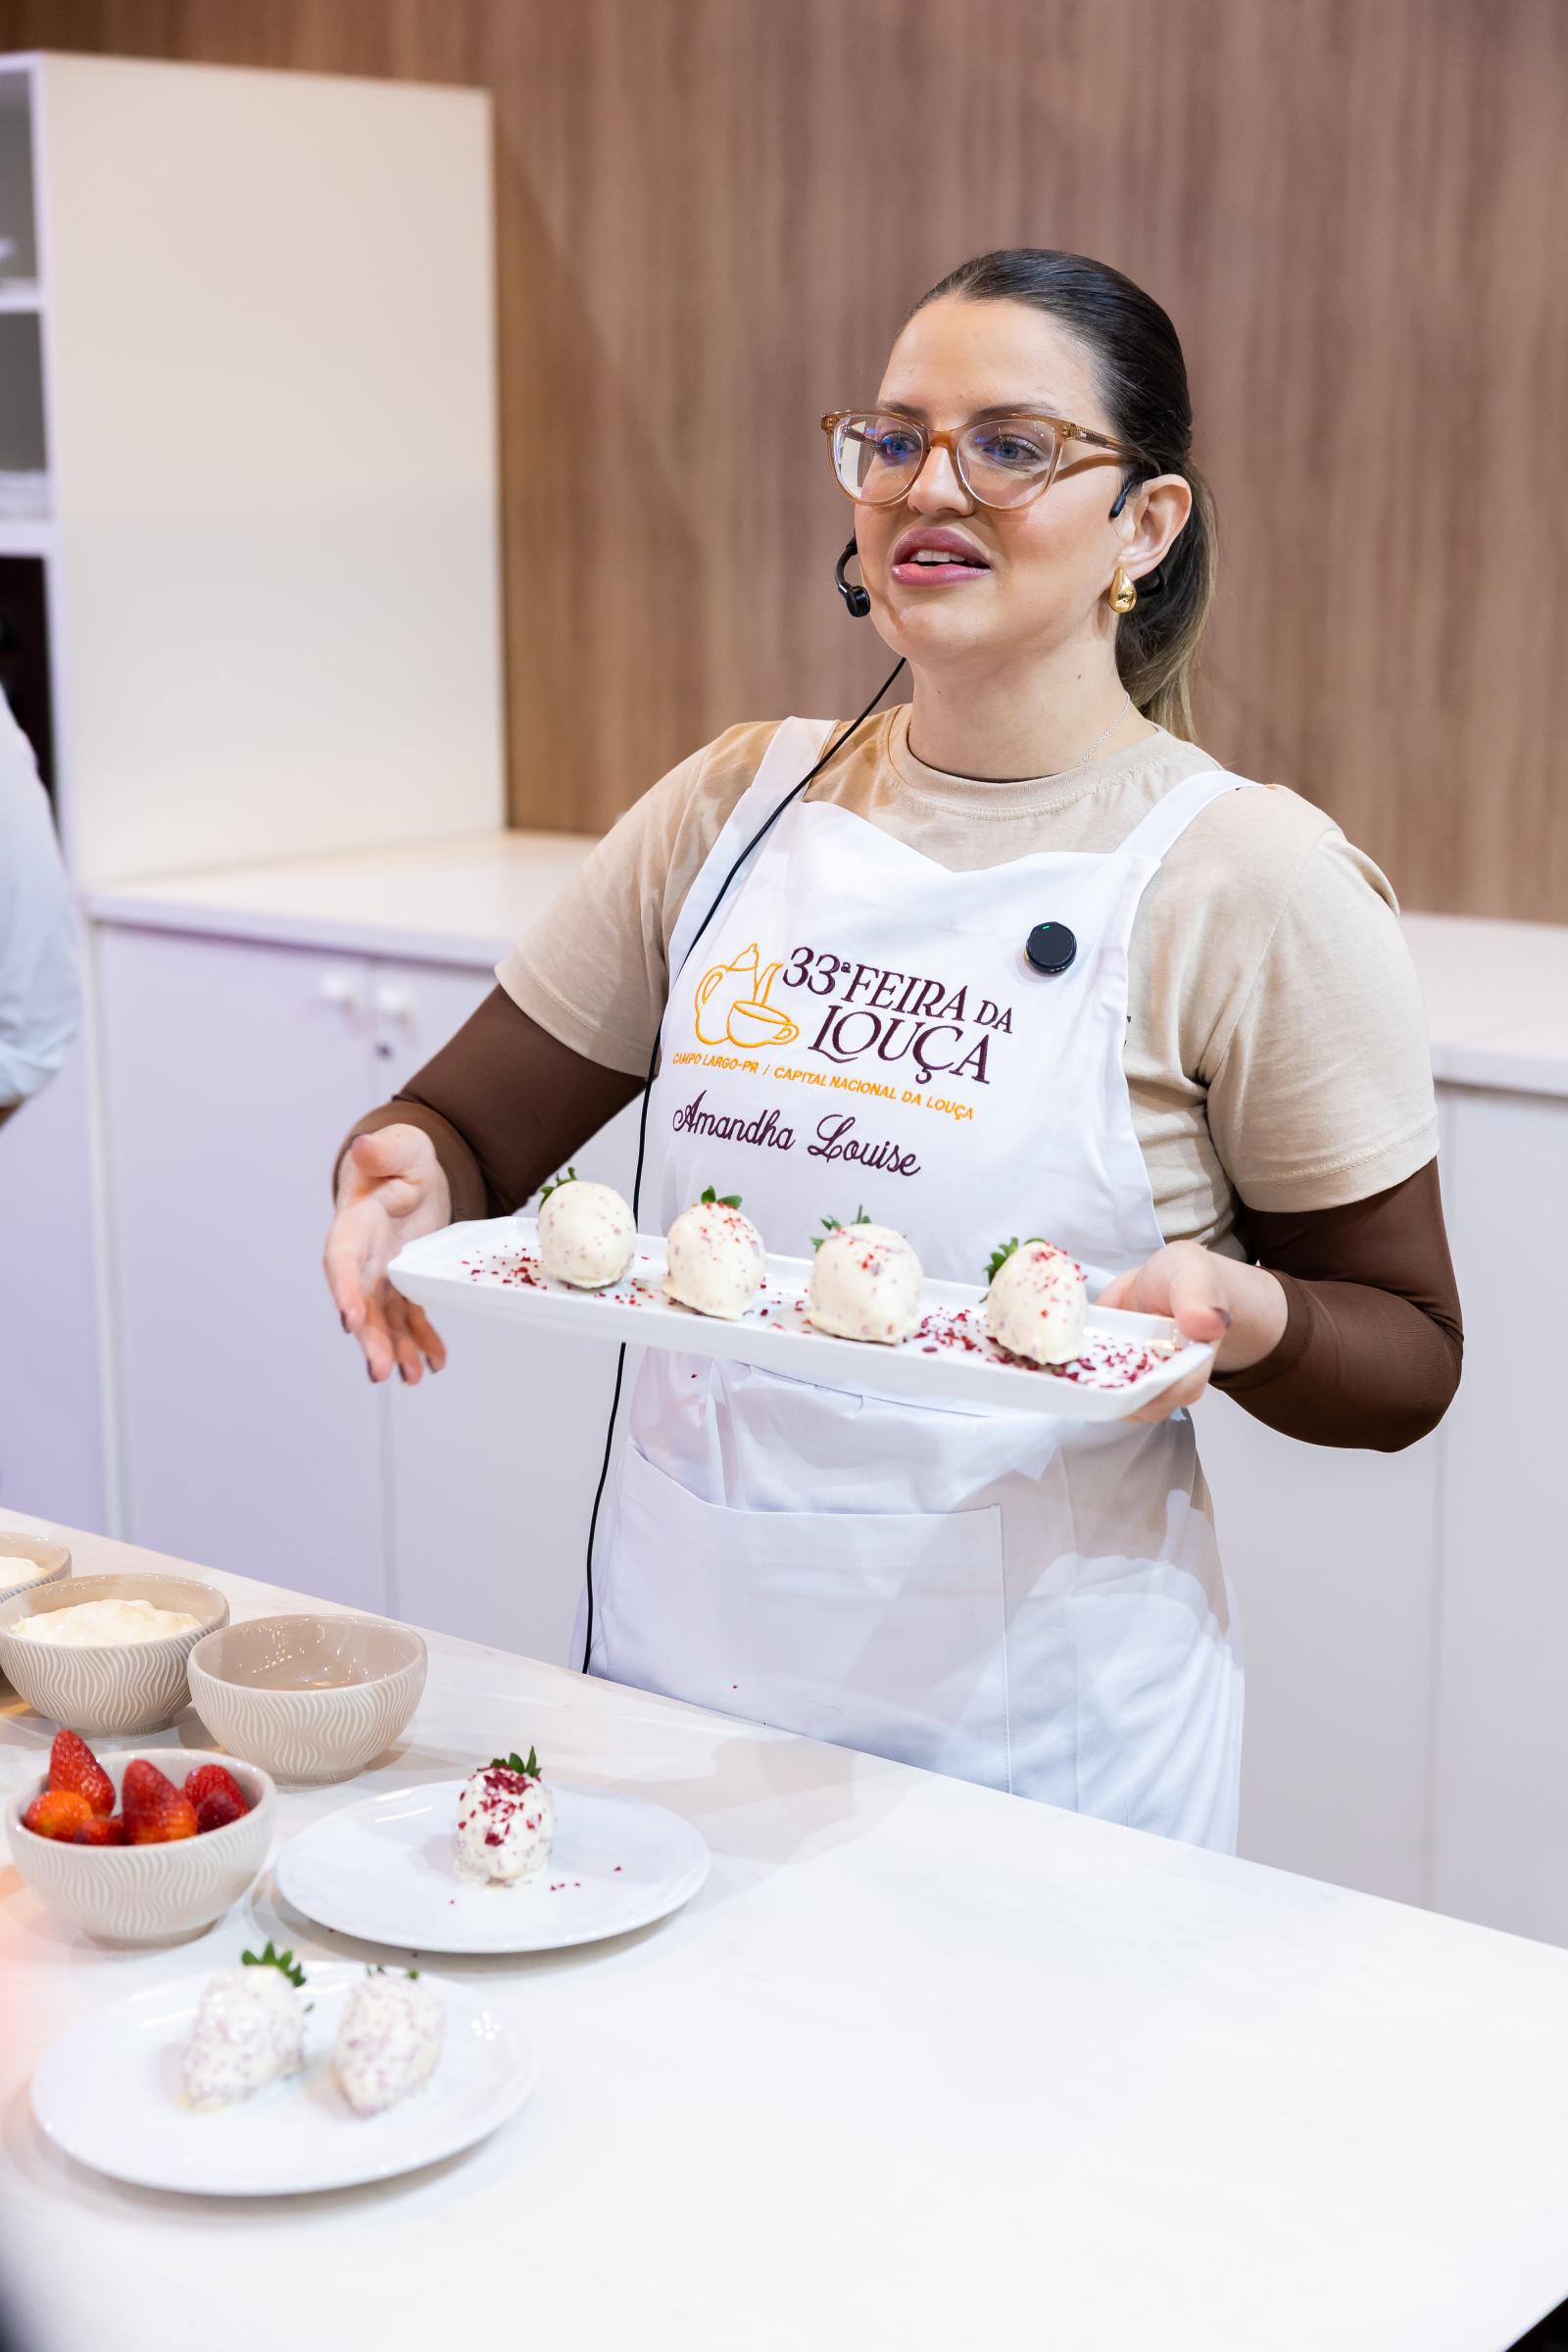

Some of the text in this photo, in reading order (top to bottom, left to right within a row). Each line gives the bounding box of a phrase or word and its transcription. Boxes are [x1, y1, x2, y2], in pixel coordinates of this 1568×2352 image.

[840, 963, 968, 1022] FEIRA
[973, 1000, 1013, 1035] DA
[808, 1004, 991, 1085] LOUÇA
[672, 1051, 703, 1066] CAMPO
[773, 1064, 827, 1088] CAPITAL
[829, 1075, 898, 1101] NACIONAL
[901, 1090, 922, 1106] DA
[926, 1096, 974, 1121] LOUÇA
[673, 1089, 921, 1177] Amandha Louise
